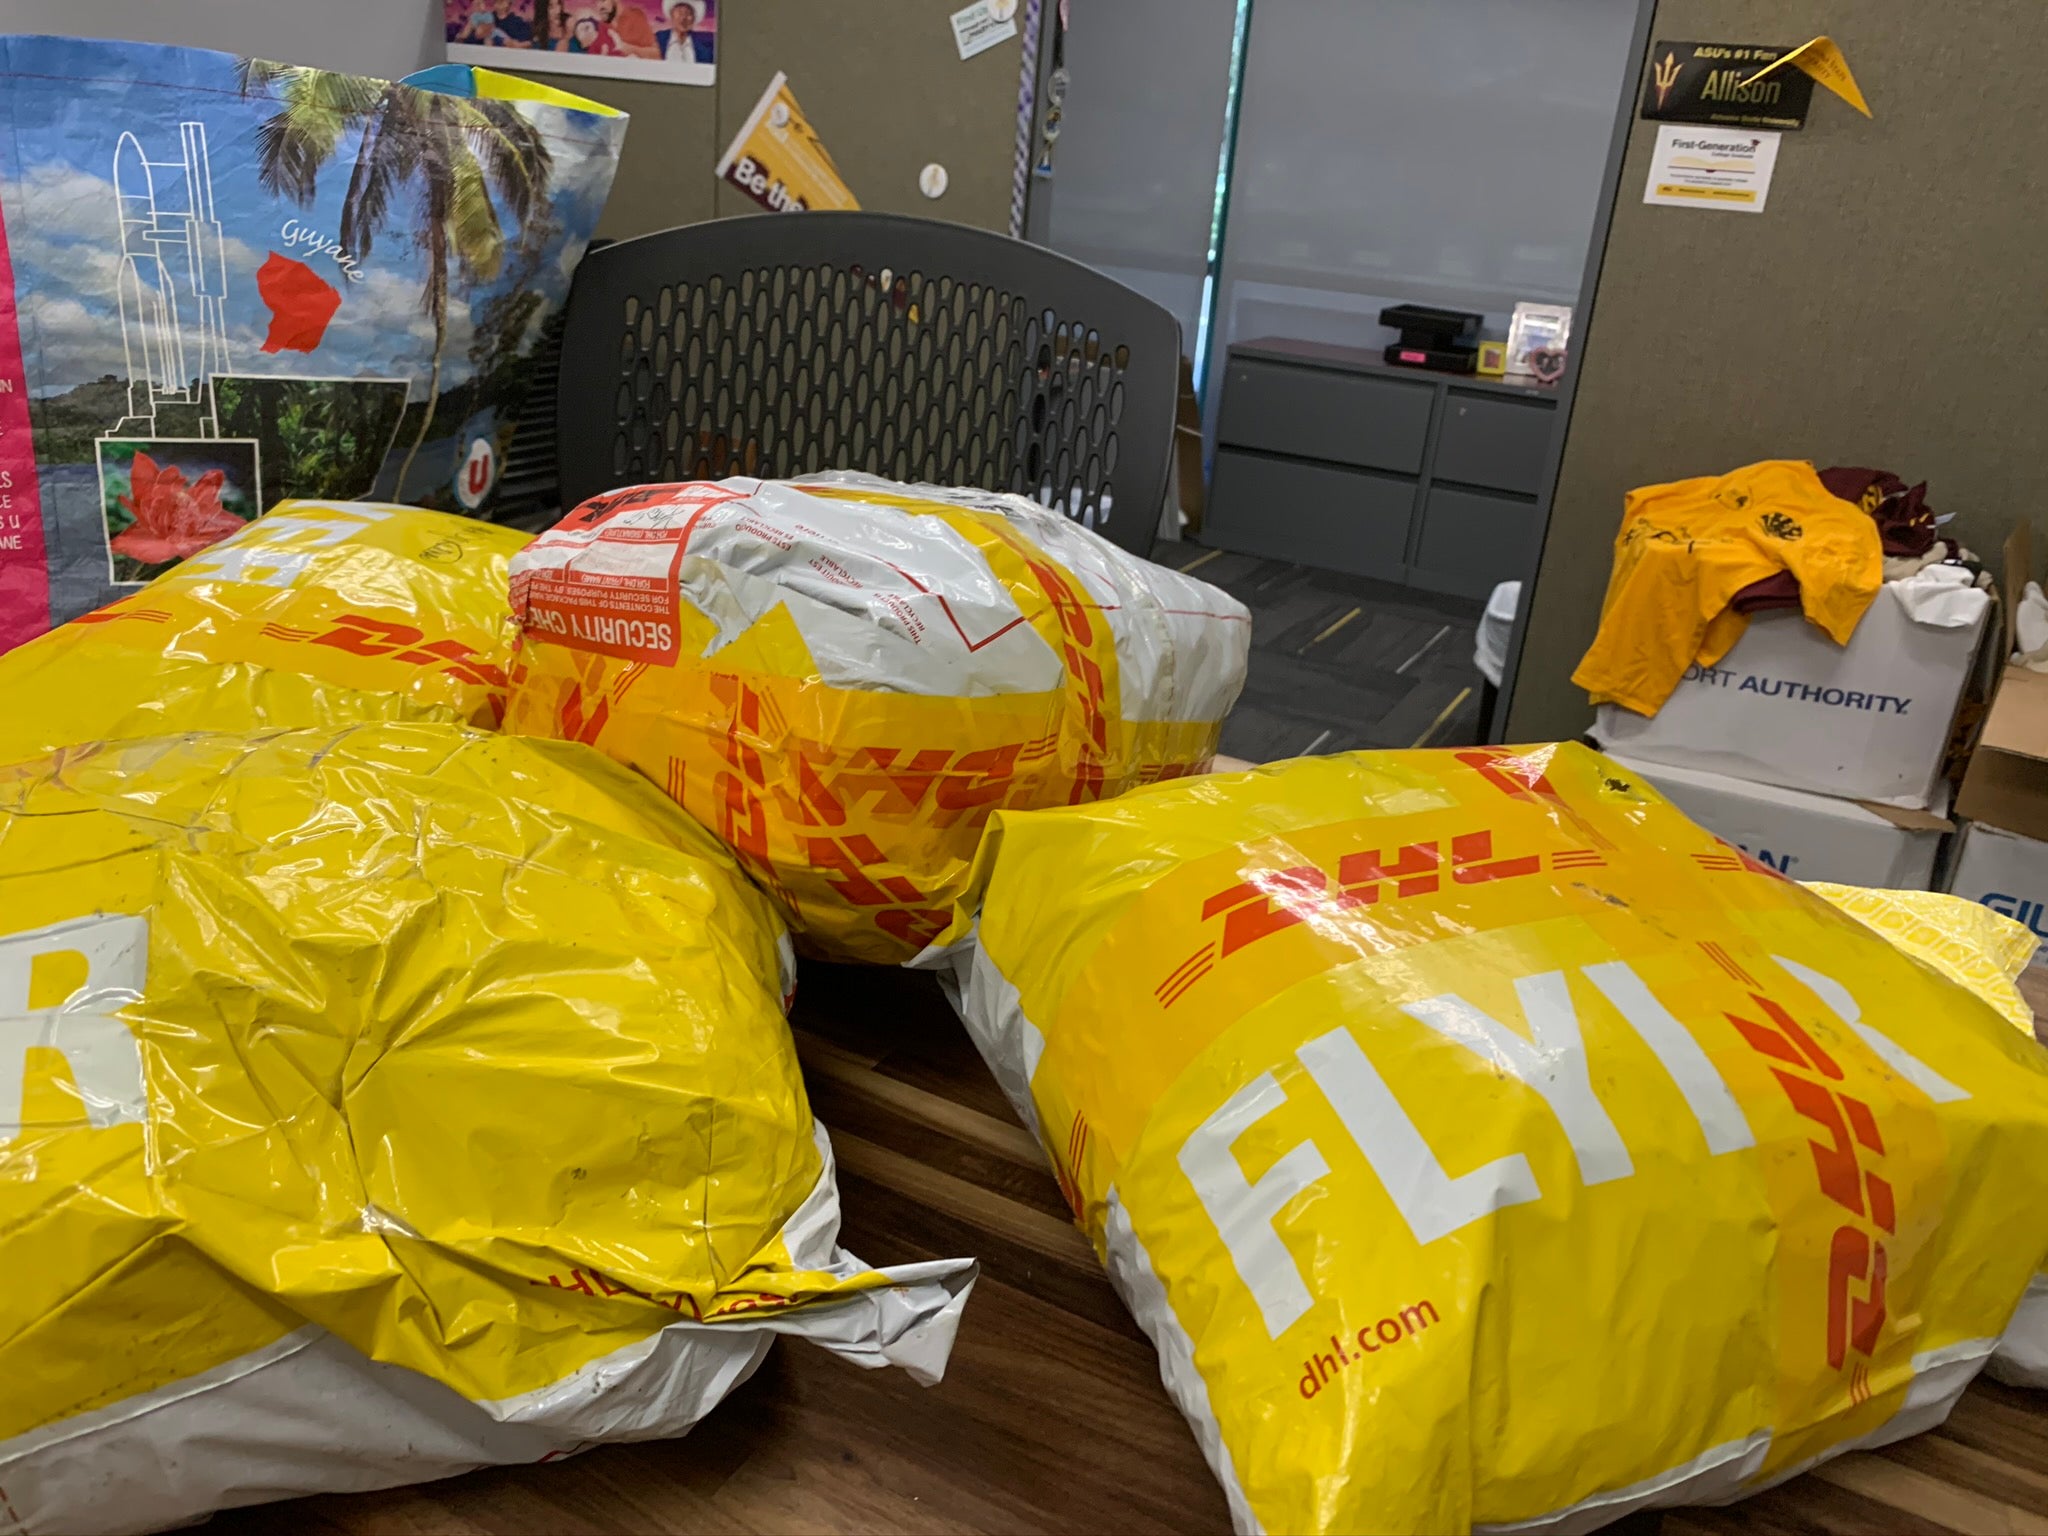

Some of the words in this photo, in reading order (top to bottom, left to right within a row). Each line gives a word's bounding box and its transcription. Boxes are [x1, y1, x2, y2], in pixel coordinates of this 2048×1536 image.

[1694, 47, 1731, 59] ASU's
[1701, 69, 1781, 104] Allison
[1671, 138, 1757, 154] First-Generation
[733, 156, 768, 195] Be
[280, 218, 365, 284] Guyane
[597, 598, 609, 610] OF
[609, 590, 651, 604] SECURITY
[609, 599, 655, 613] CONTENTS
[651, 594, 670, 606] FOR
[654, 603, 670, 615] THE
[571, 613, 672, 651] SECURITY
[905, 624, 922, 645] THIS
[1200, 830, 1542, 959] DHL
[1722, 993, 1896, 1370] DHL
[1296, 1299, 1440, 1403] dhl.com
